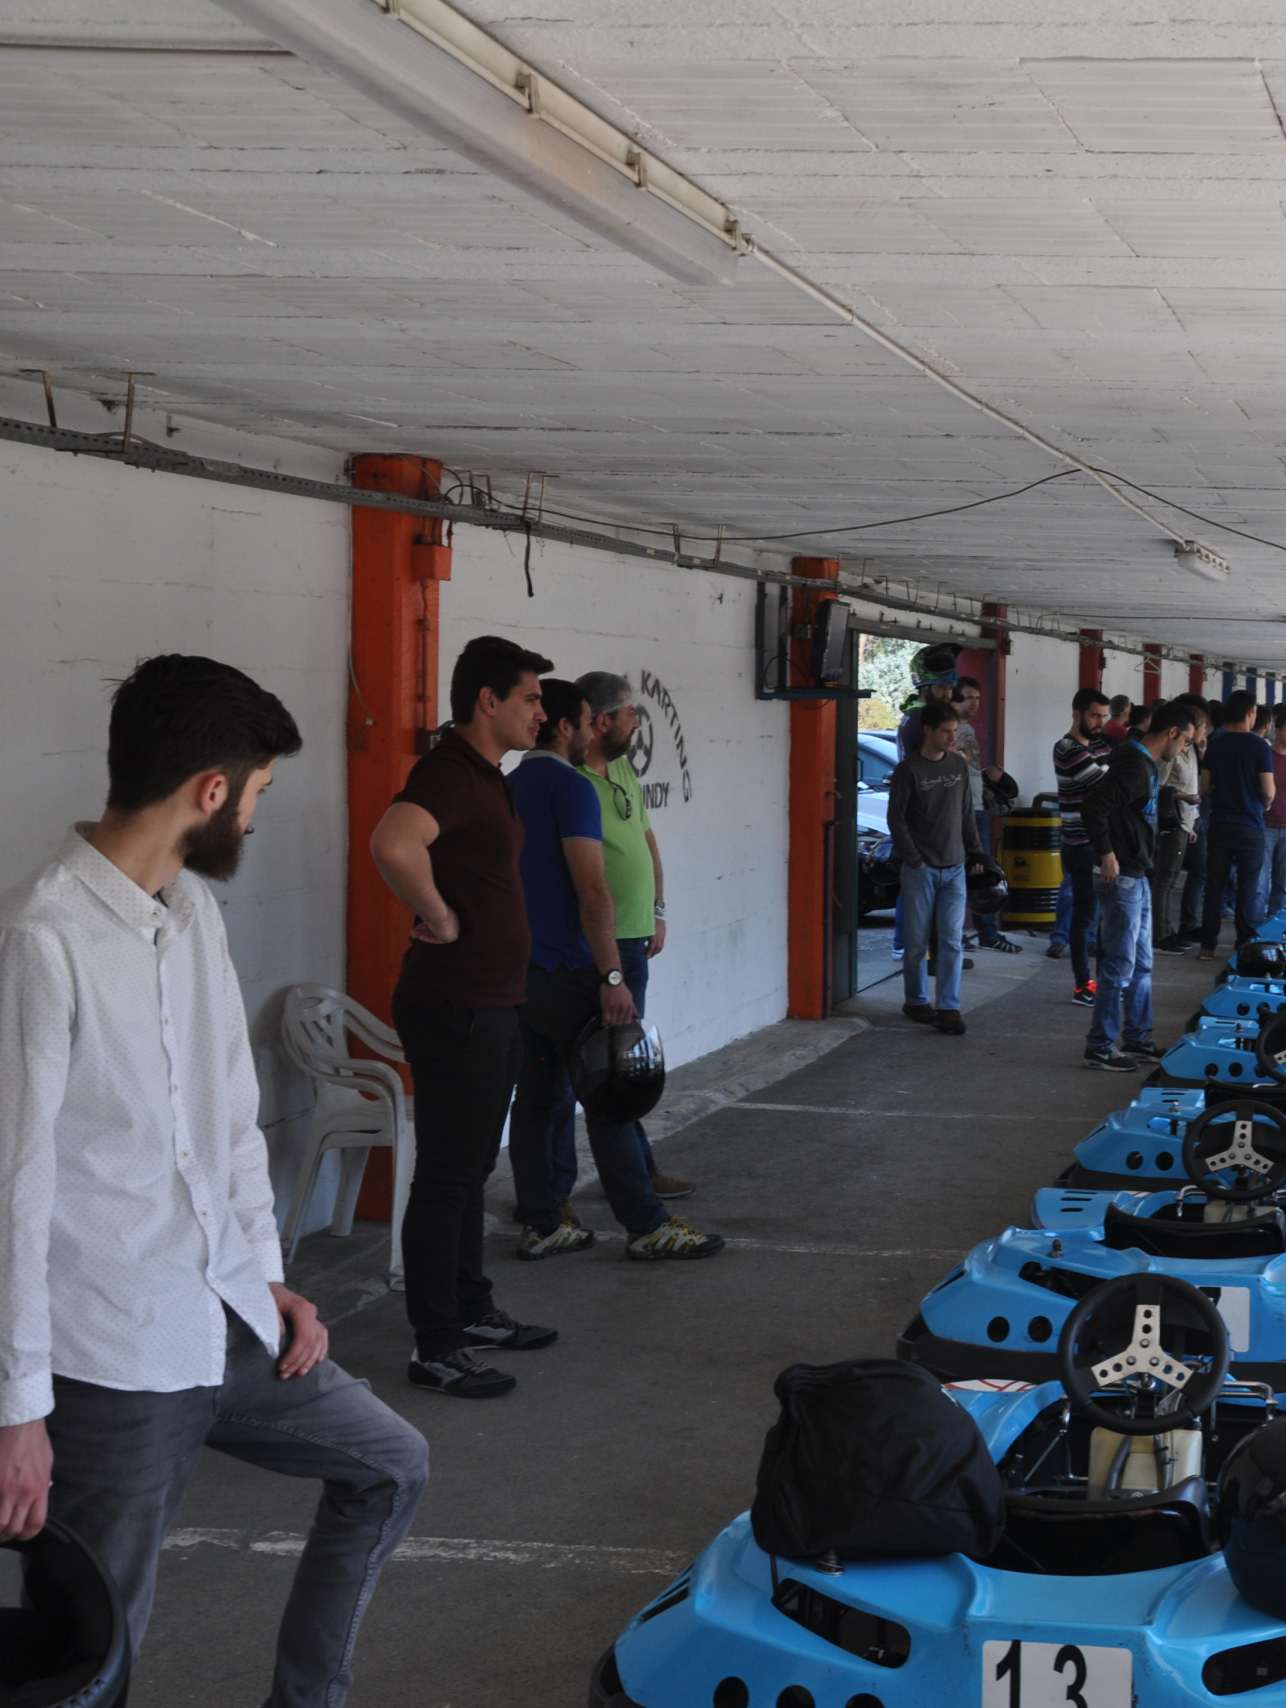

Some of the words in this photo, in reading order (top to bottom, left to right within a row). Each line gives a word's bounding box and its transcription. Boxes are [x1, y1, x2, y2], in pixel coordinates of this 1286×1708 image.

[641, 669, 692, 803] KARTING
[642, 782, 670, 809] INDY
[995, 1639, 1089, 1708] 13
